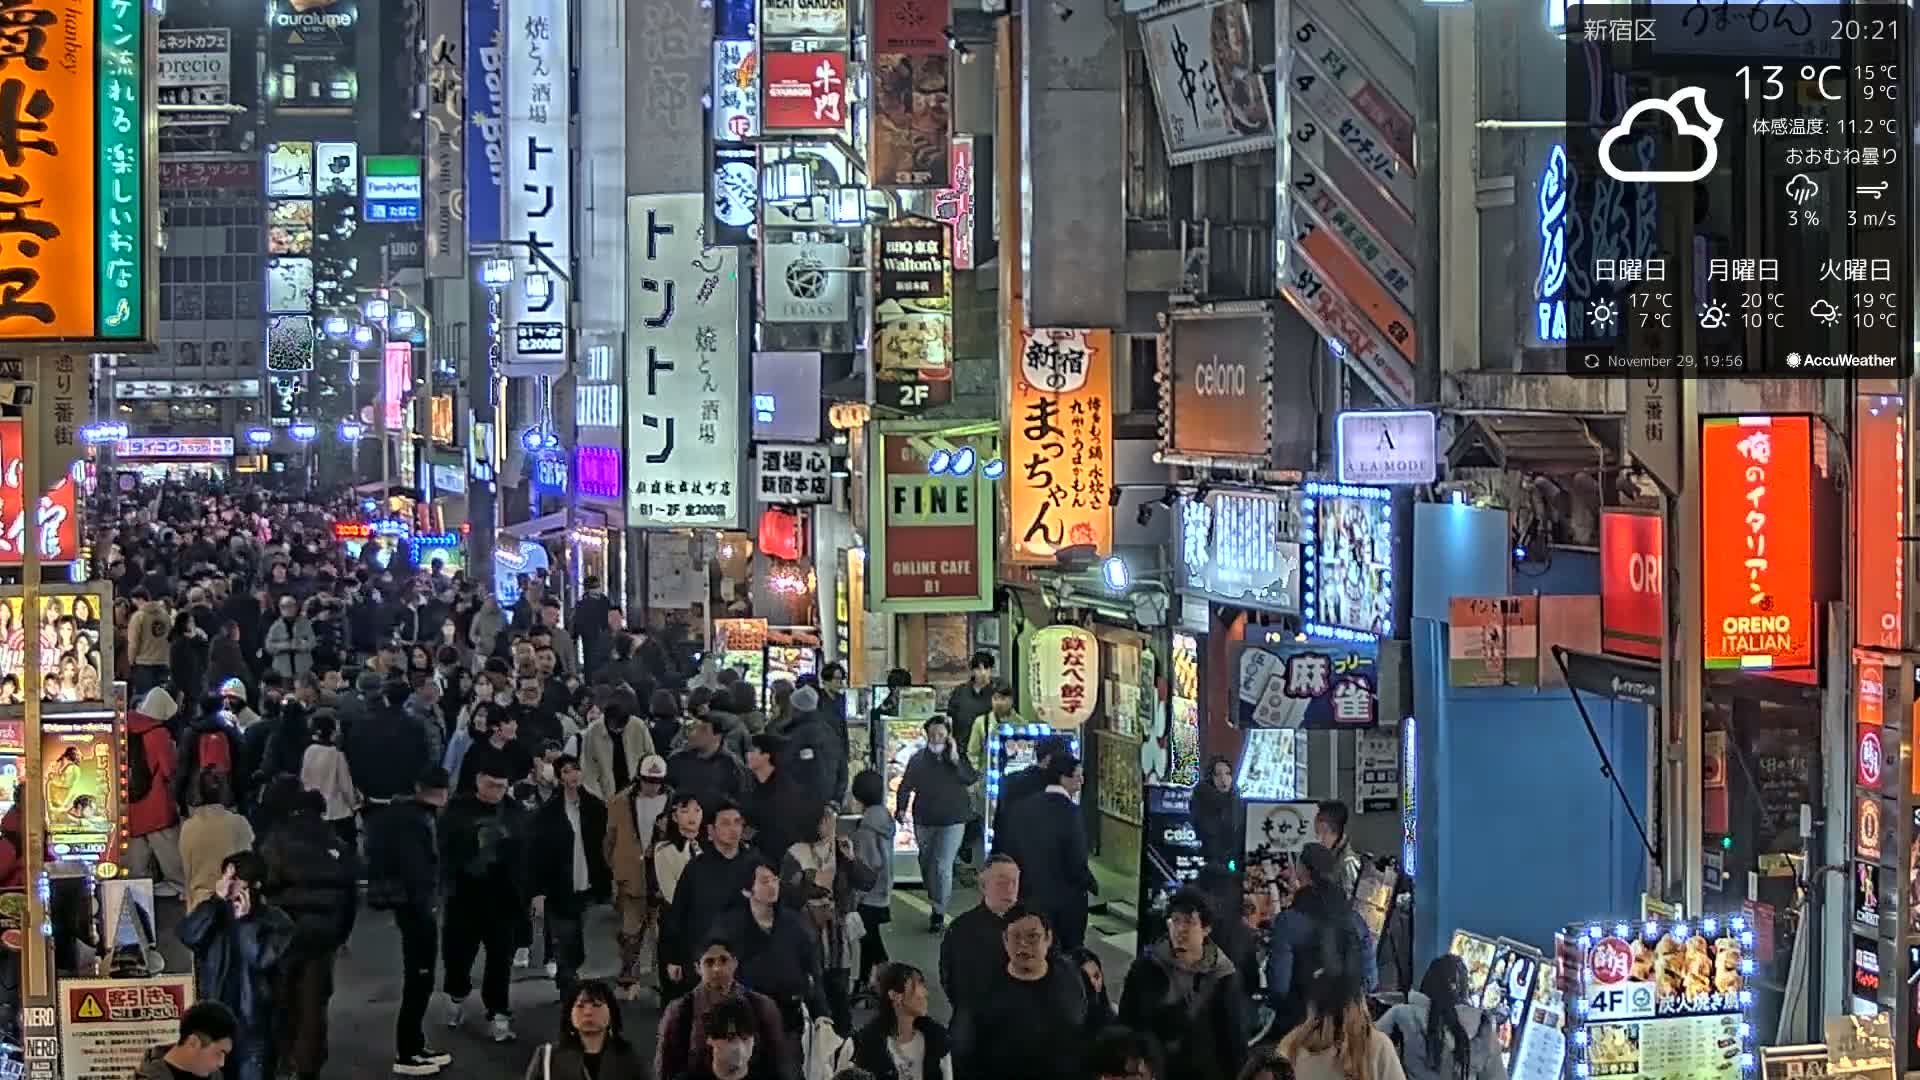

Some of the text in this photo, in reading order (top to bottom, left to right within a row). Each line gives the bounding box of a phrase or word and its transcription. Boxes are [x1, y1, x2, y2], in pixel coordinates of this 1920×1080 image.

[1295, 23, 1317, 43] 5
[812, 59, 841, 122] 牛門
[1296, 75, 1315, 92] 4
[1296, 123, 1316, 143] 3
[367, 181, 418, 194] FamilyMart
[1295, 173, 1316, 193] 2
[883, 256, 942, 273] Walton's
[642, 208, 674, 464] トントン
[1195, 359, 1246, 396] celona
[899, 385, 929, 406] 2F
[761, 450, 827, 473] 酒場心
[1023, 396, 1068, 545] まっちゃん
[761, 475, 827, 494] 新宿本店
[894, 486, 970, 515] FINE
[1738, 431, 1772, 605] 俺のイタリアン
[892, 560, 971, 576] ONLINE CAFE
[1723, 616, 1790, 633] ORENO
[1722, 634, 1791, 653] ITALIAN
[1289, 656, 1373, 722] 麻雀
[1591, 990, 1624, 1013] 4F
[23, 1007, 55, 1027] NERO
[26, 1038, 57, 1057] NERO
